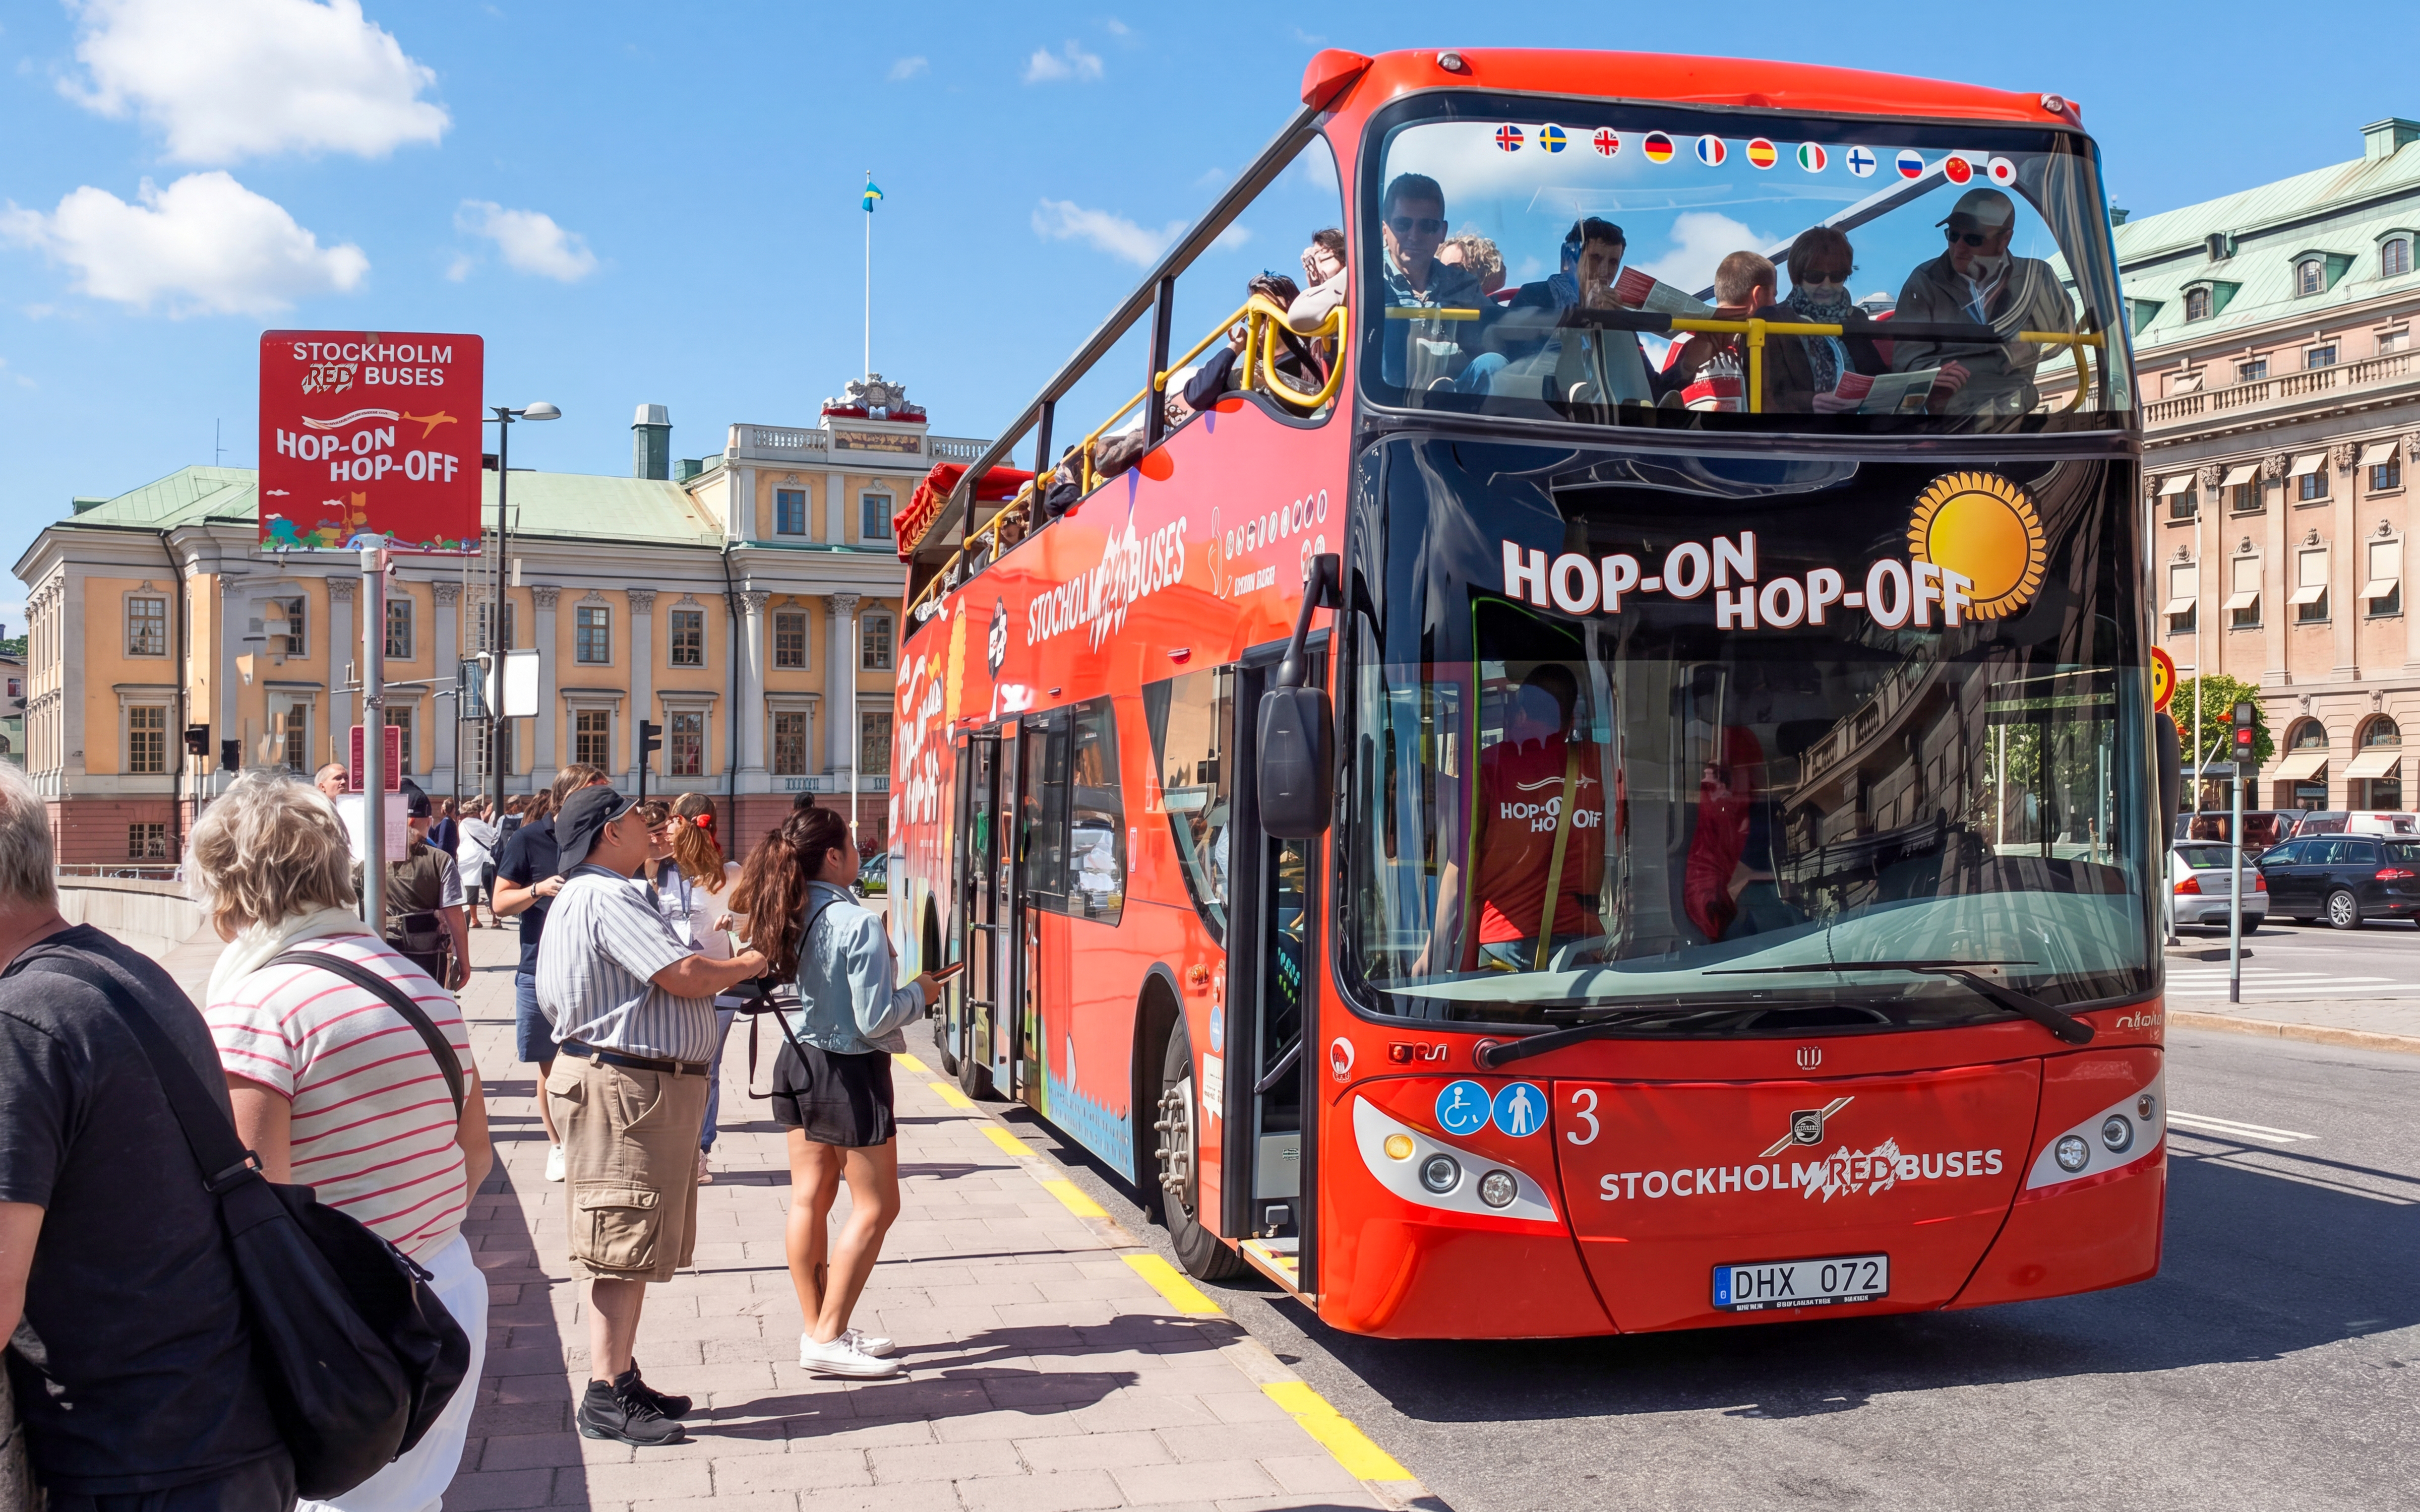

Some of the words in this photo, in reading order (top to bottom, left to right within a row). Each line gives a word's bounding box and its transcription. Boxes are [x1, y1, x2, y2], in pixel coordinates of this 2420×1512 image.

[293, 342, 452, 364] STOCKHOLM
[365, 366, 444, 386] BUSES
[276, 425, 395, 461] HOP-ON
[330, 450, 459, 482] HOP-OFF
[1128, 515, 1187, 604] BUSES
[1503, 531, 1757, 614] HOP-ON
[1716, 558, 1974, 629] HOP-OFF
[1500, 796, 1563, 819] HOP-O
[1567, 1088, 1600, 1146] 3
[1600, 1161, 1821, 1201] STOCKHOLM
[1897, 1149, 2003, 1181] BUSES
[1735, 1267, 1795, 1299] DHX
[1821, 1261, 1879, 1293] 072
